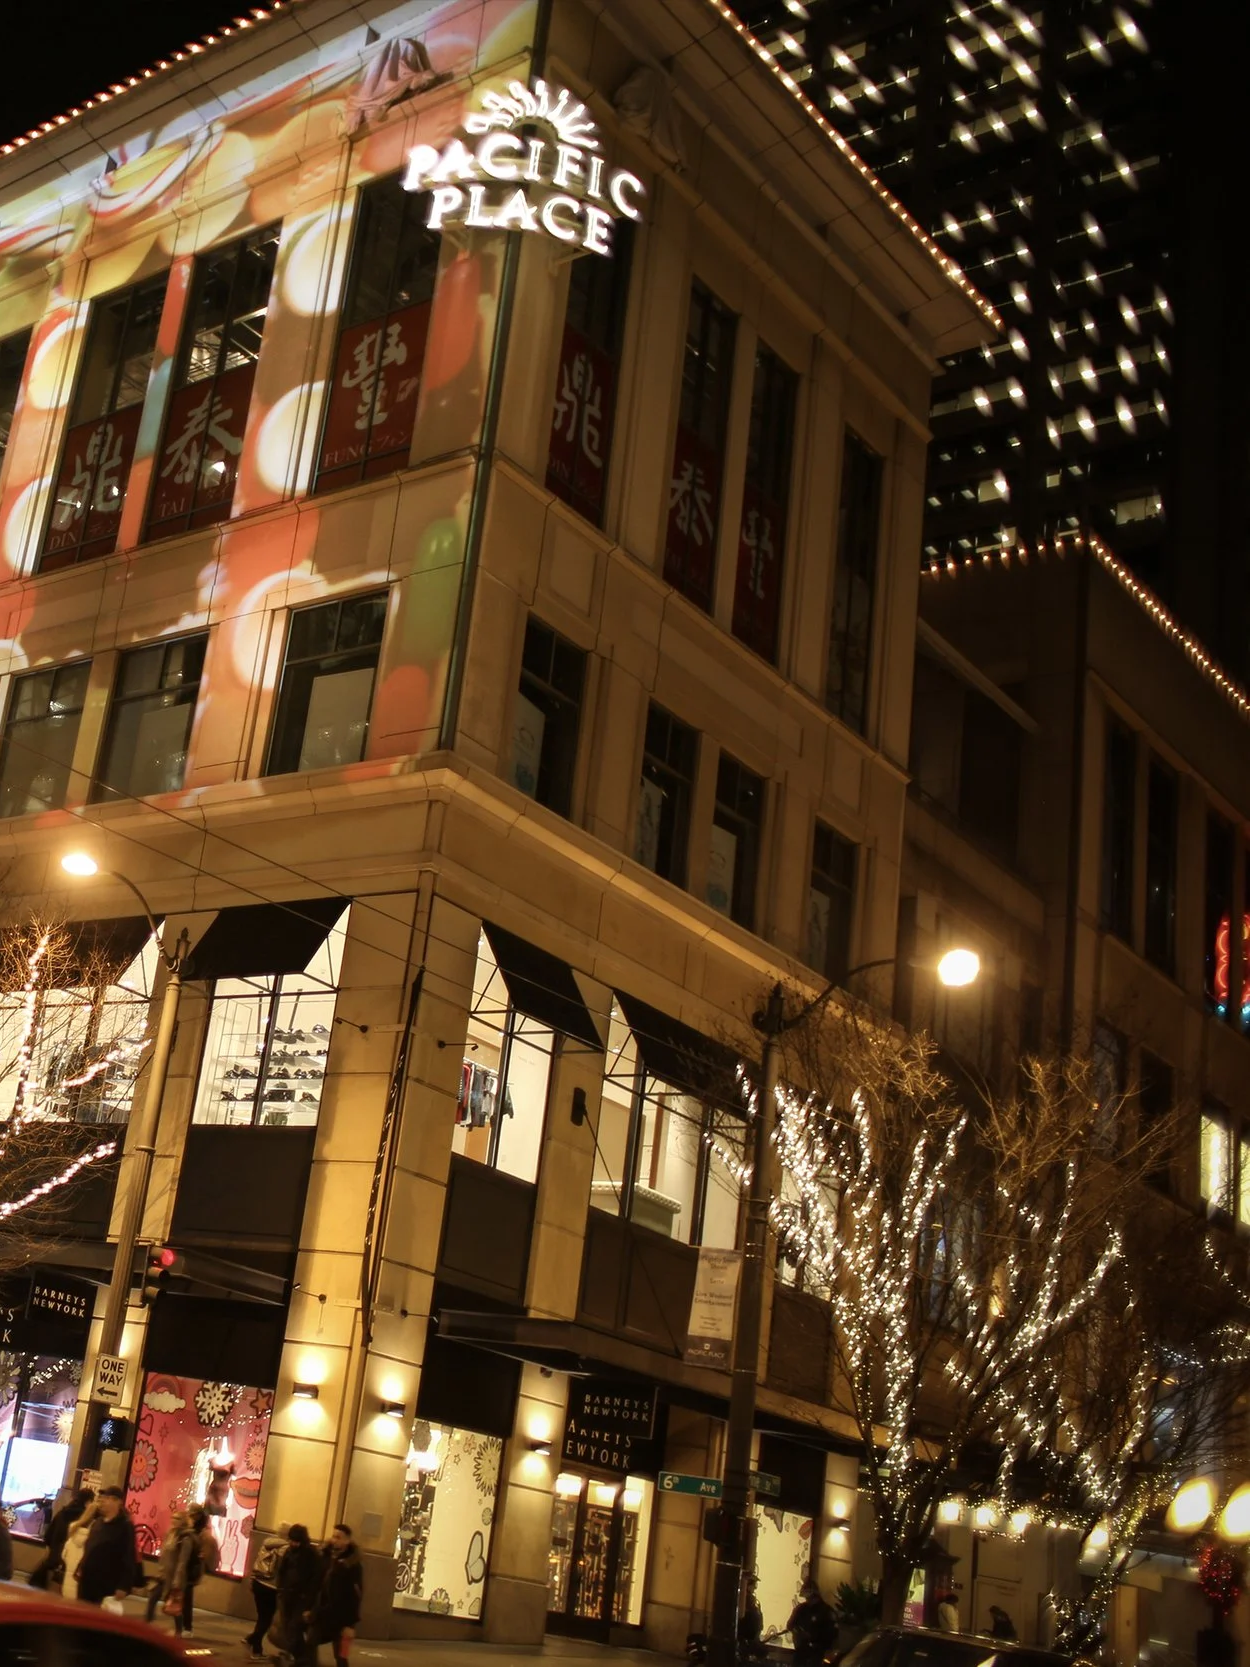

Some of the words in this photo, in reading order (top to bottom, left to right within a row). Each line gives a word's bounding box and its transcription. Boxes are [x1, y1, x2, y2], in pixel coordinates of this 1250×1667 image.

[403, 131, 643, 221] PACIFIC
[426, 184, 613, 256] PLACE
[160, 389, 243, 490] 泰
[324, 443, 374, 468] FUNG
[49, 531, 79, 551] DIN
[34, 1286, 87, 1306] BARNEYS
[101, 1359, 125, 1373] ONE
[100, 1371, 123, 1386] WAY
[584, 1393, 649, 1410] BARNEYS
[699, 1481, 717, 1494] Ave
